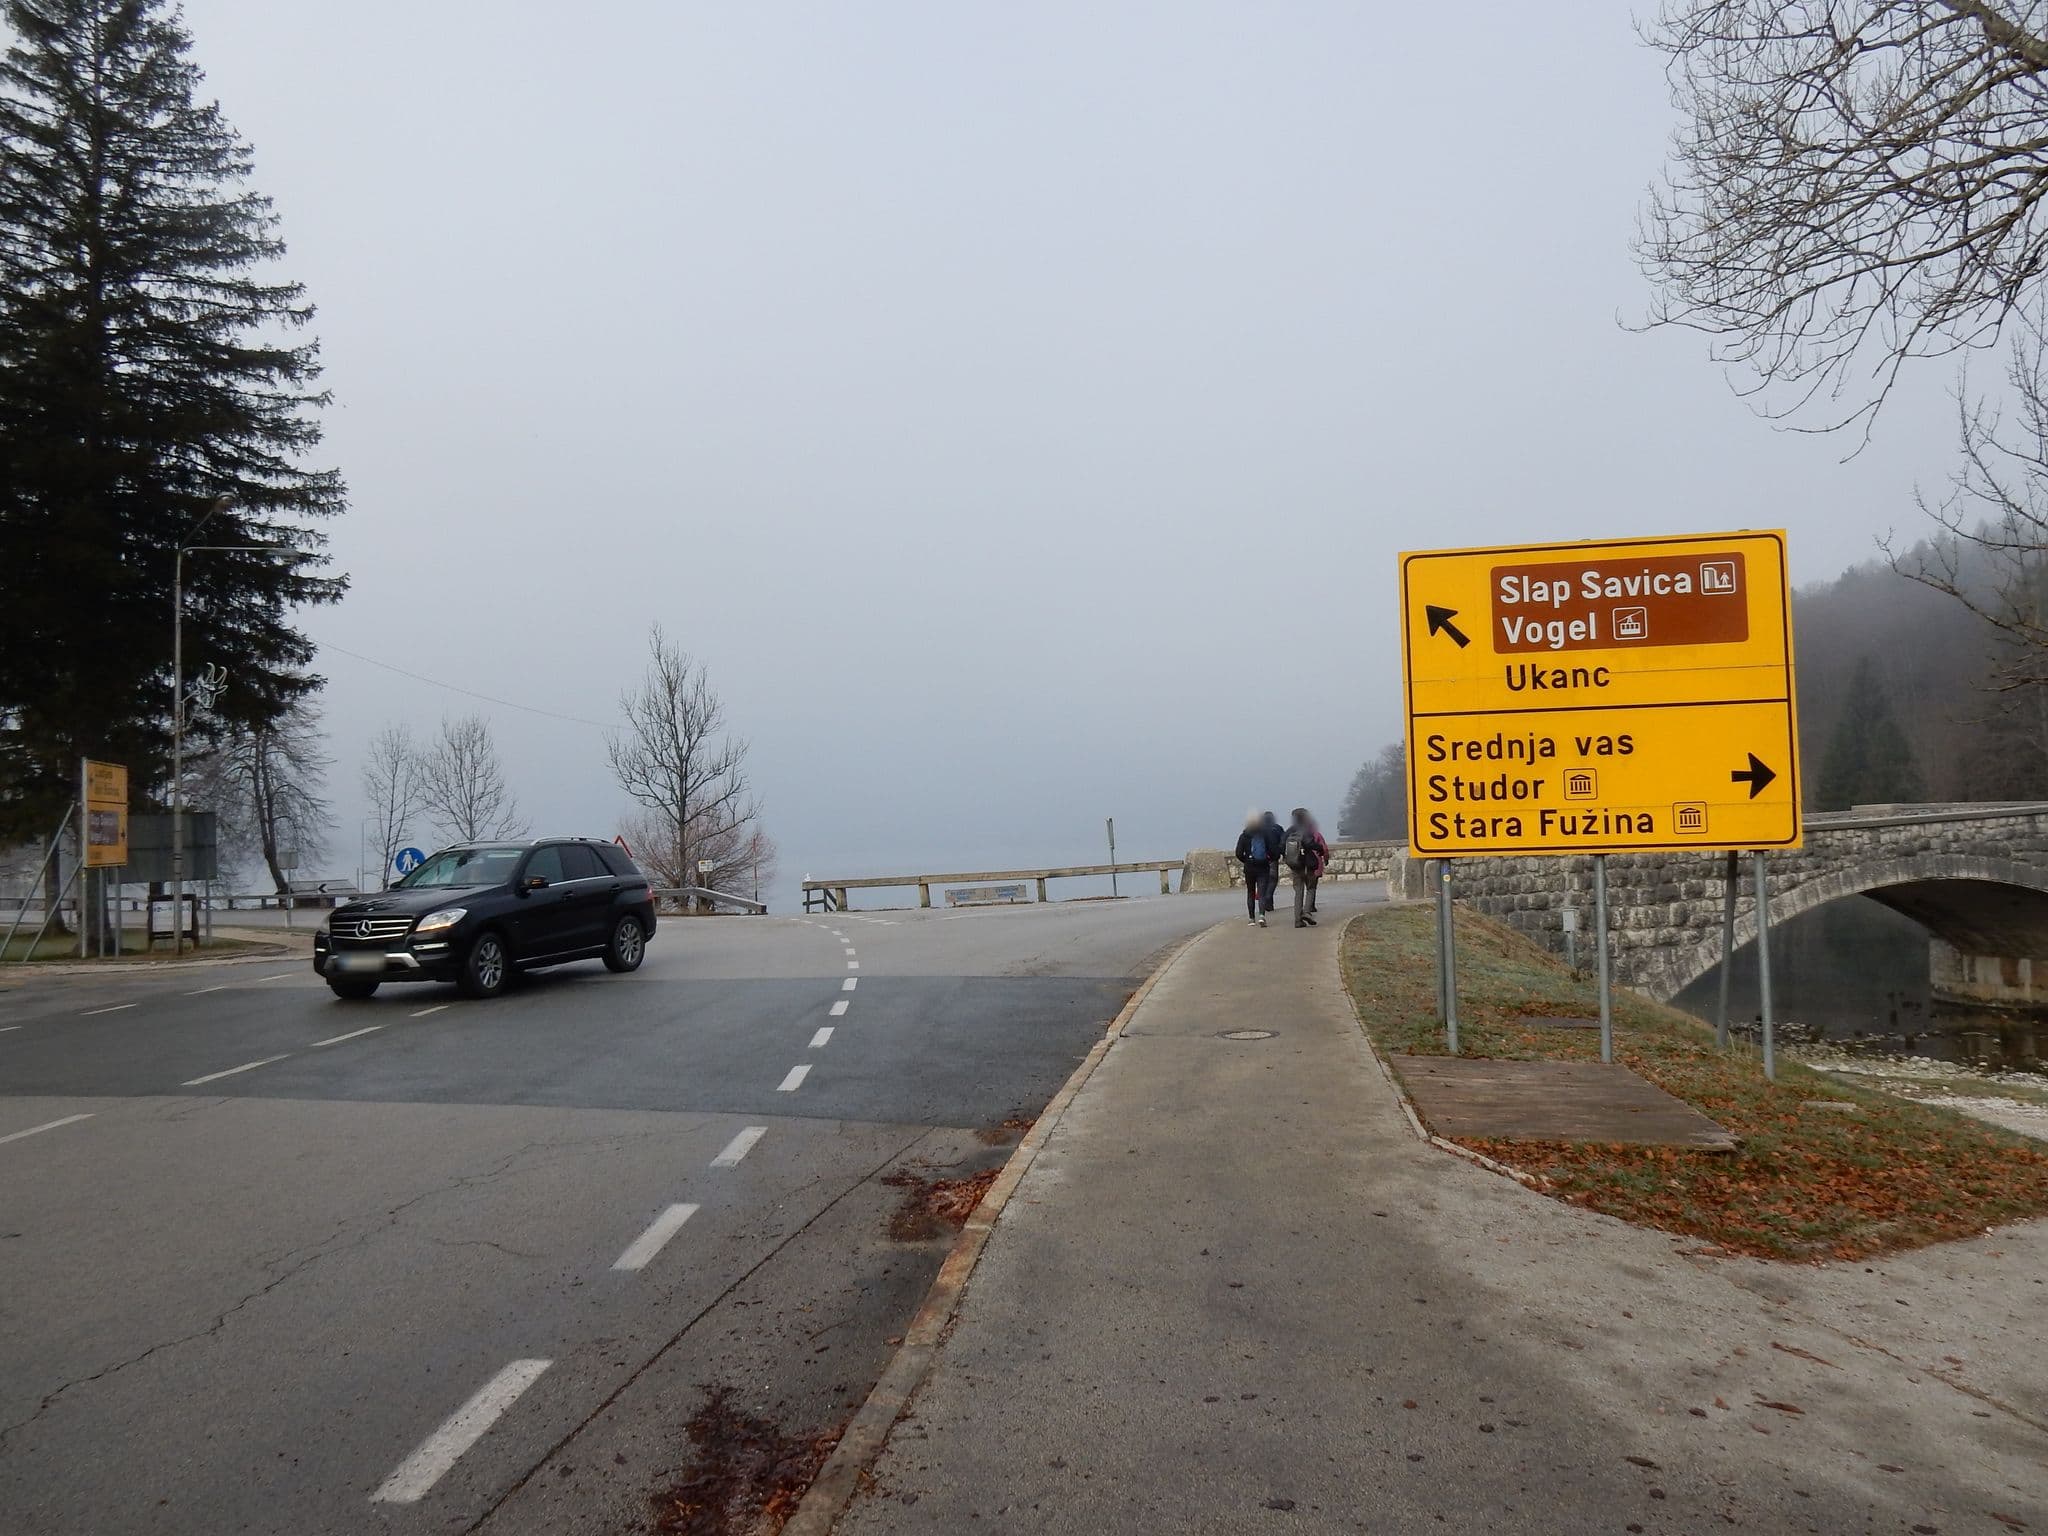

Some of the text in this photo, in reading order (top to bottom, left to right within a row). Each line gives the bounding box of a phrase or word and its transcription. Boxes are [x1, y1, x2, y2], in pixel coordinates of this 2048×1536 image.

[1499, 568, 1692, 608] Slap Savica
[1502, 613, 1597, 649] Vogel
[1506, 663, 1610, 691] Ukanc
[1427, 732, 1634, 766] Srednja vas
[1428, 773, 1545, 802] Studor
[1430, 807, 1654, 840] Stara Fužina
